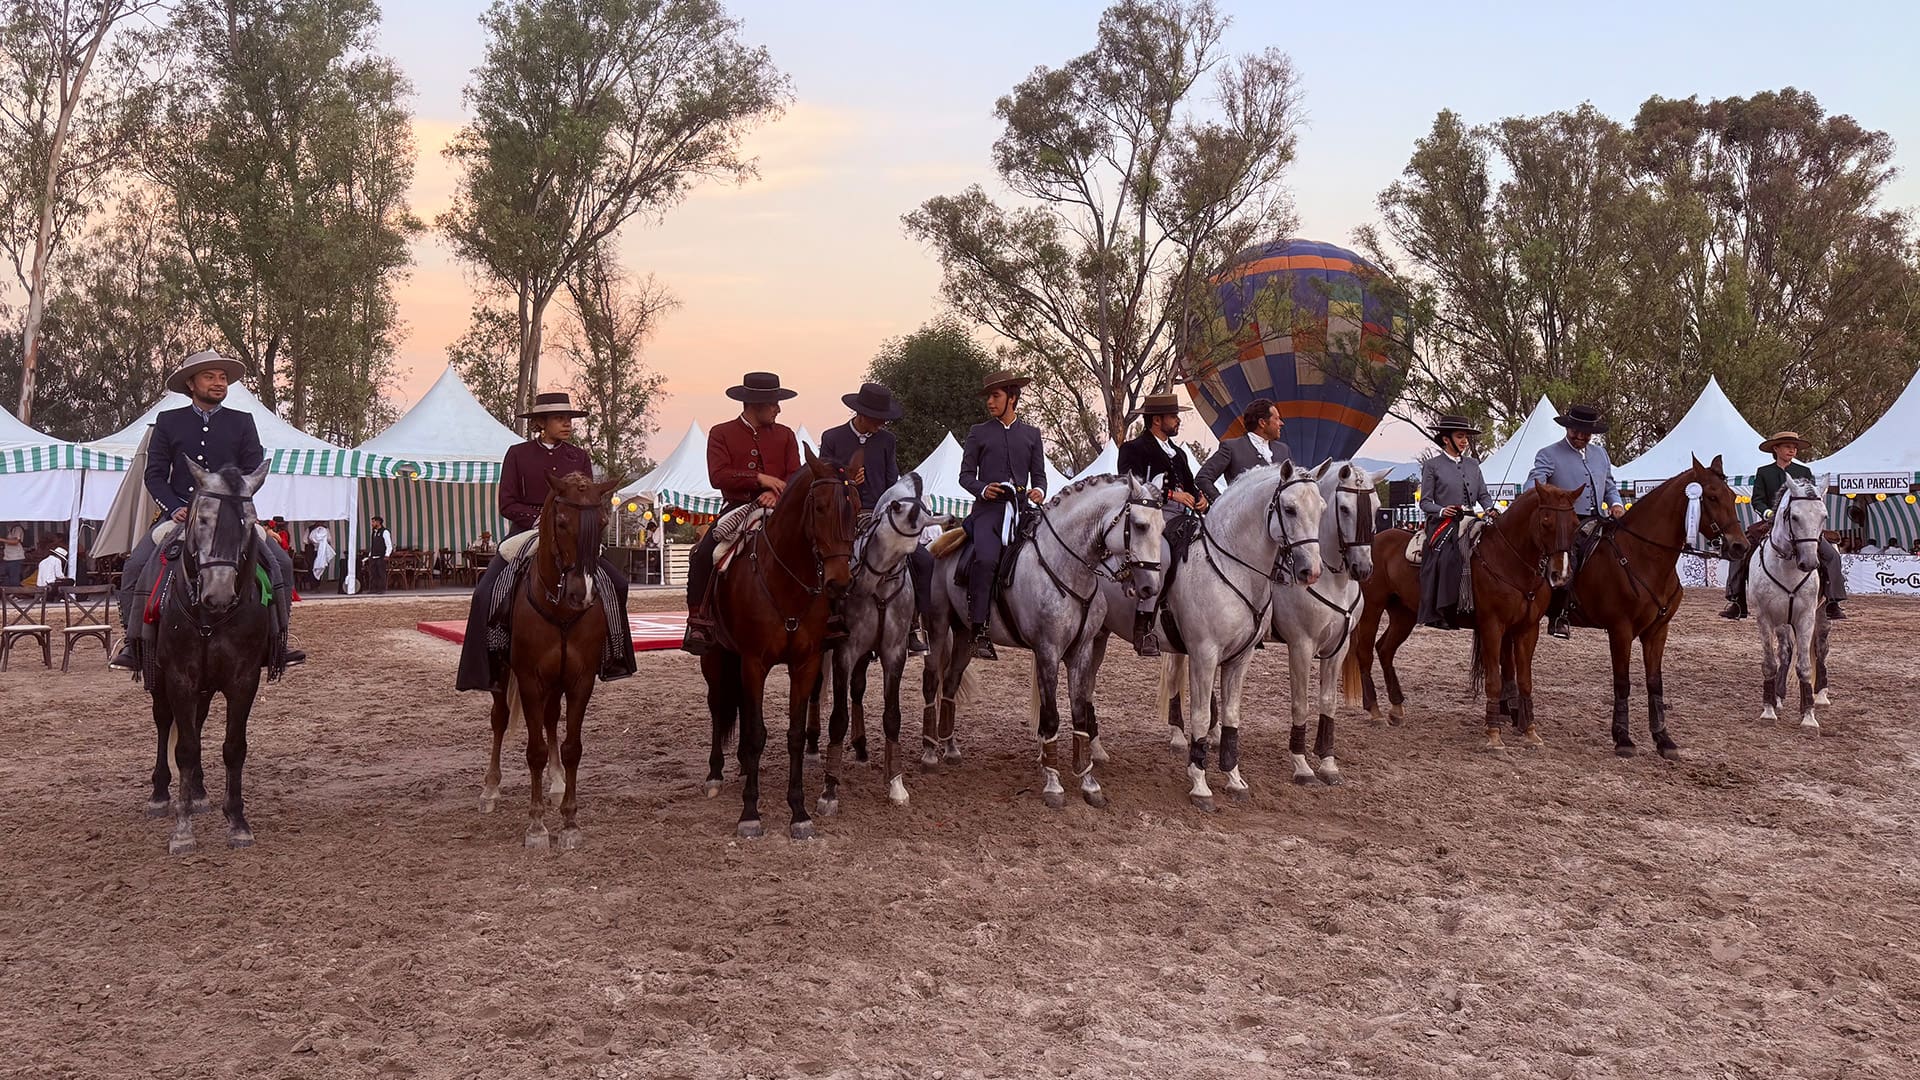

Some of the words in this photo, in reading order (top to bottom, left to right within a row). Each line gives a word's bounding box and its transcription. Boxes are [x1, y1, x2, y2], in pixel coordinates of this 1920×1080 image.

[1840, 478, 1864, 489] CASA
[1867, 477, 1908, 489] PAREDES
[1875, 571, 1906, 586] Topo
